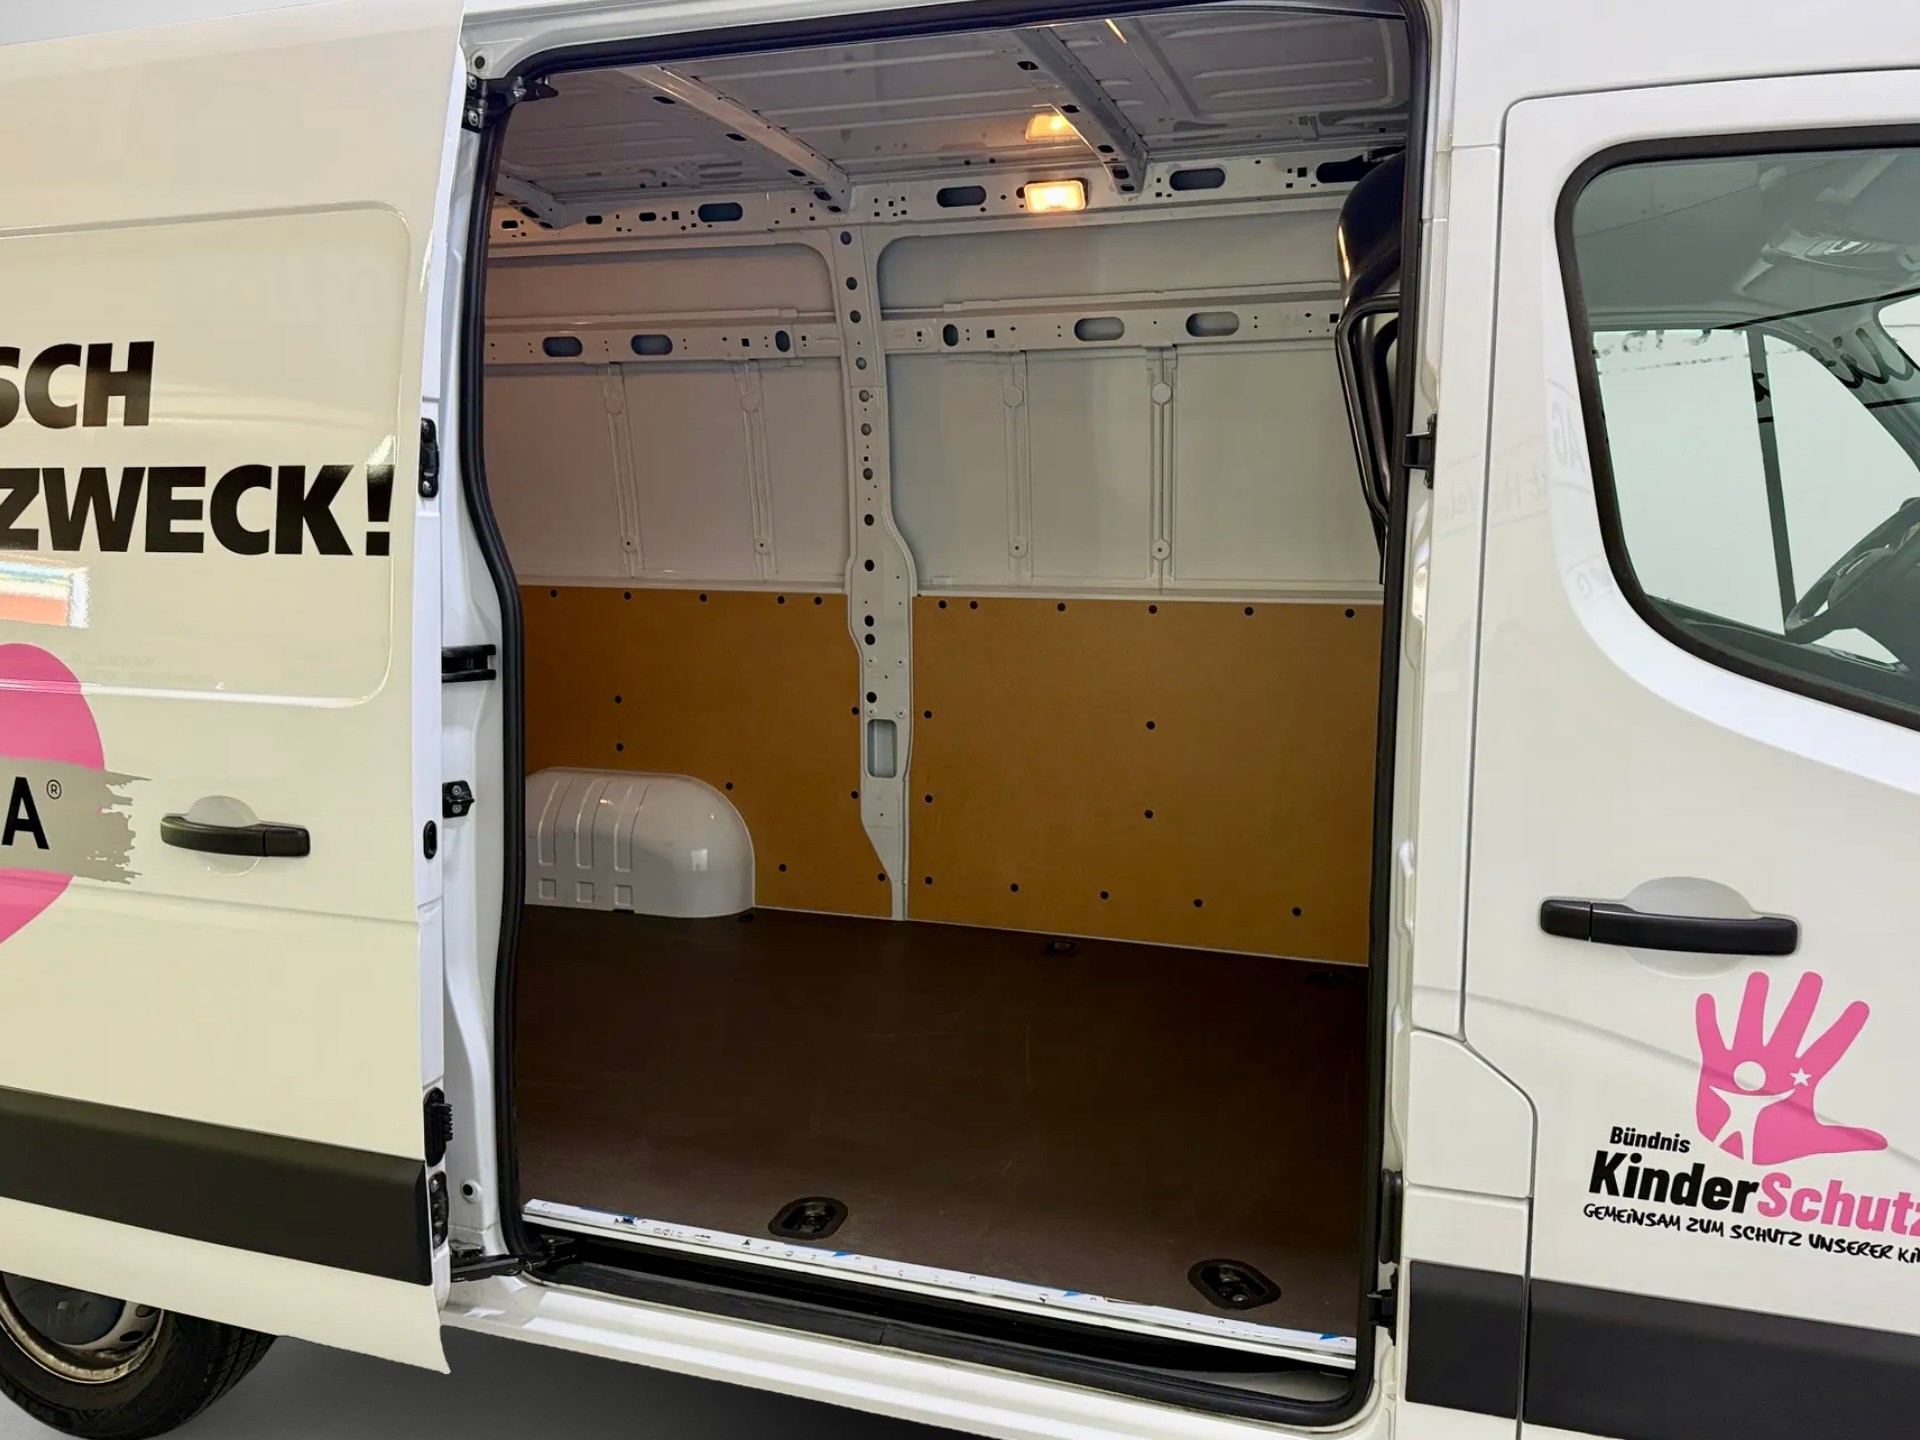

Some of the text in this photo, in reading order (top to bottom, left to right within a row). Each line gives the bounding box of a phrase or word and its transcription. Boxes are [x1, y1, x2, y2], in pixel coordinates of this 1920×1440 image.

[0, 464, 395, 556] ZWECK!
[1609, 1126, 1691, 1153] Bündnis
[1686, 1217, 1724, 1237] ZUM
[1730, 1225, 1802, 1246] SCHUTZ
[1808, 1233, 1894, 1259] UNSERER
